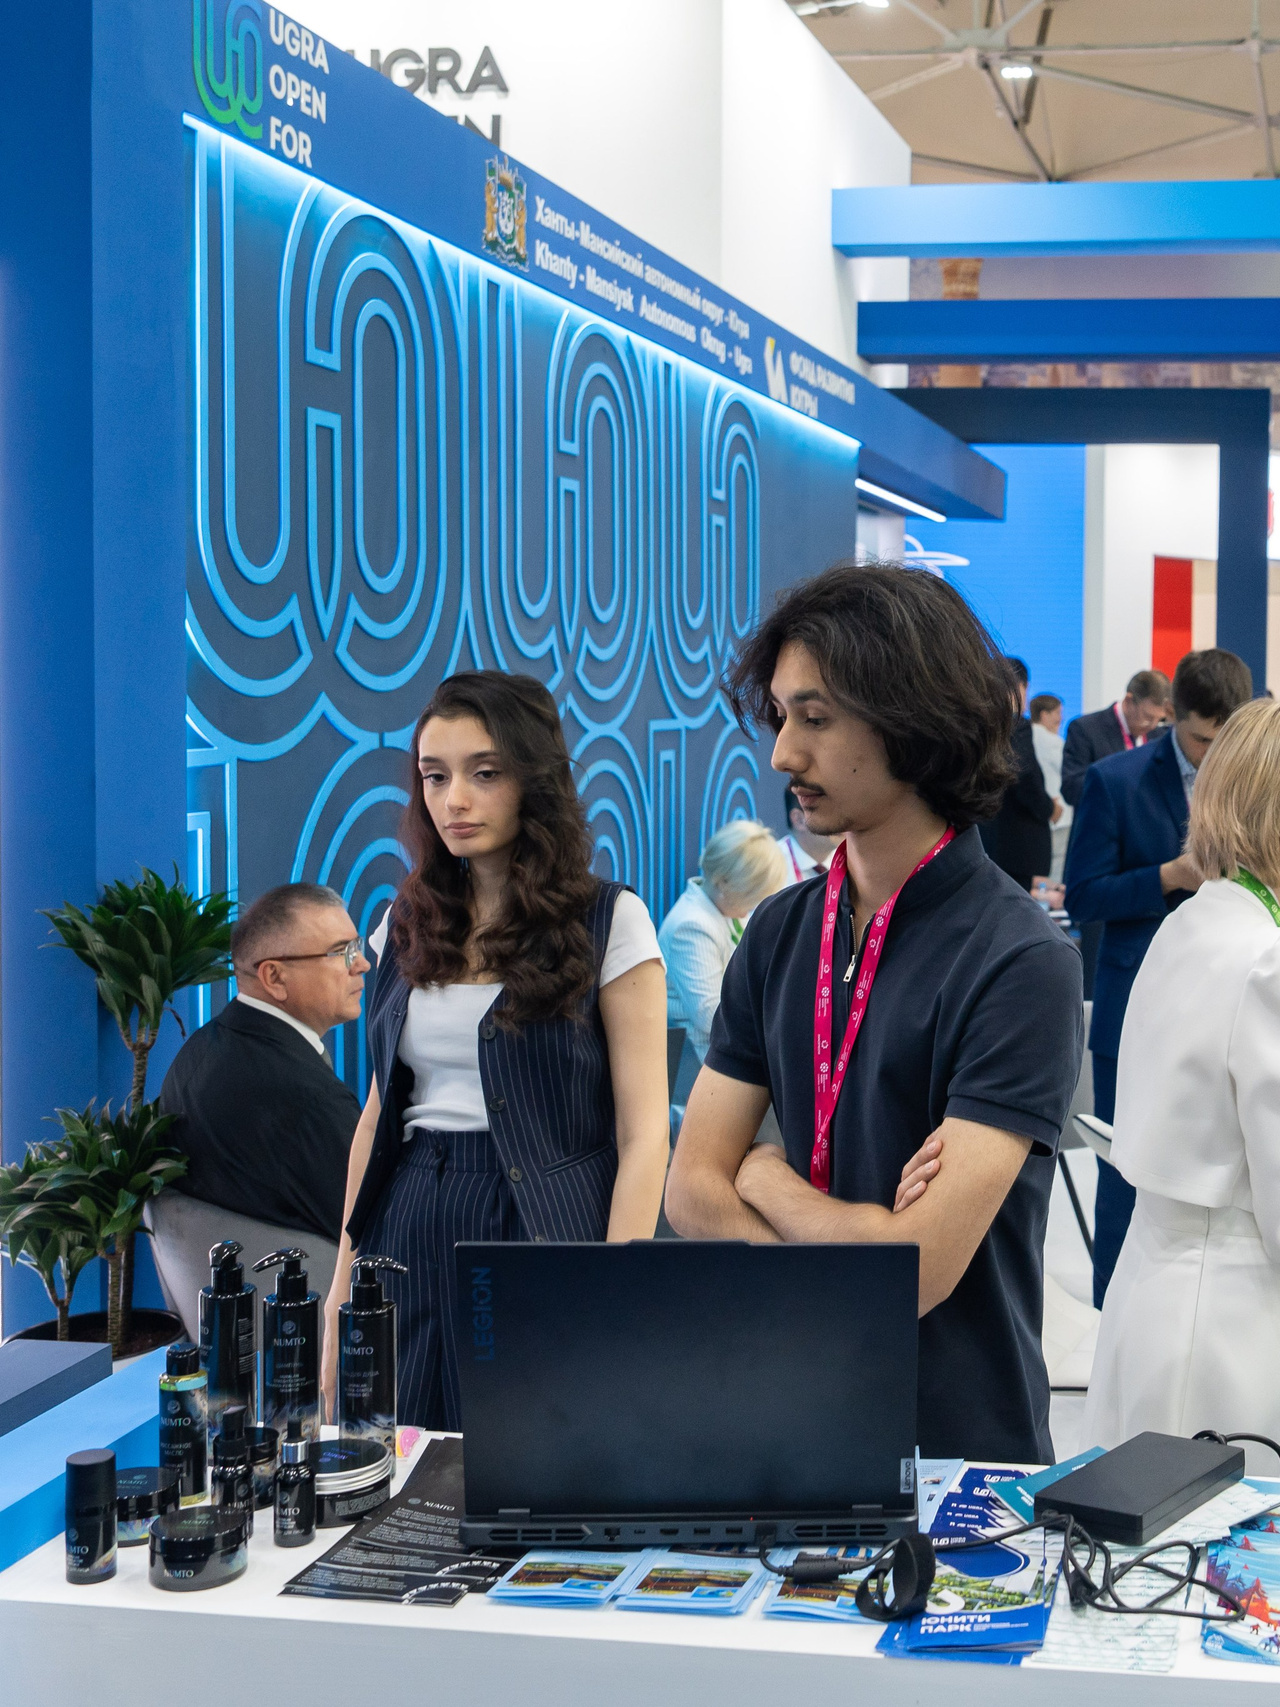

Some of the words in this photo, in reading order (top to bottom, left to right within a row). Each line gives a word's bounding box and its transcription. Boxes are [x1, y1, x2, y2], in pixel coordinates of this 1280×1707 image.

[268, 8, 330, 75] UGRA
[268, 64, 327, 124] OPEN
[270, 115, 312, 169] FOR
[640, 294, 696, 343] Autonomous
[471, 1266, 494, 1361] LEGION
[273, 1337, 306, 1347] NUMTO
[343, 1346, 374, 1356] NUMTO
[160, 1417, 191, 1427] NUMTO
[902, 1461, 912, 1491] Lenovo
[424, 1501, 455, 1511] NUMTO
[163, 1569, 194, 1578] NUMTO
[921, 1615, 990, 1625] ЮНИТИ
[920, 1624, 972, 1634] ПАРК
